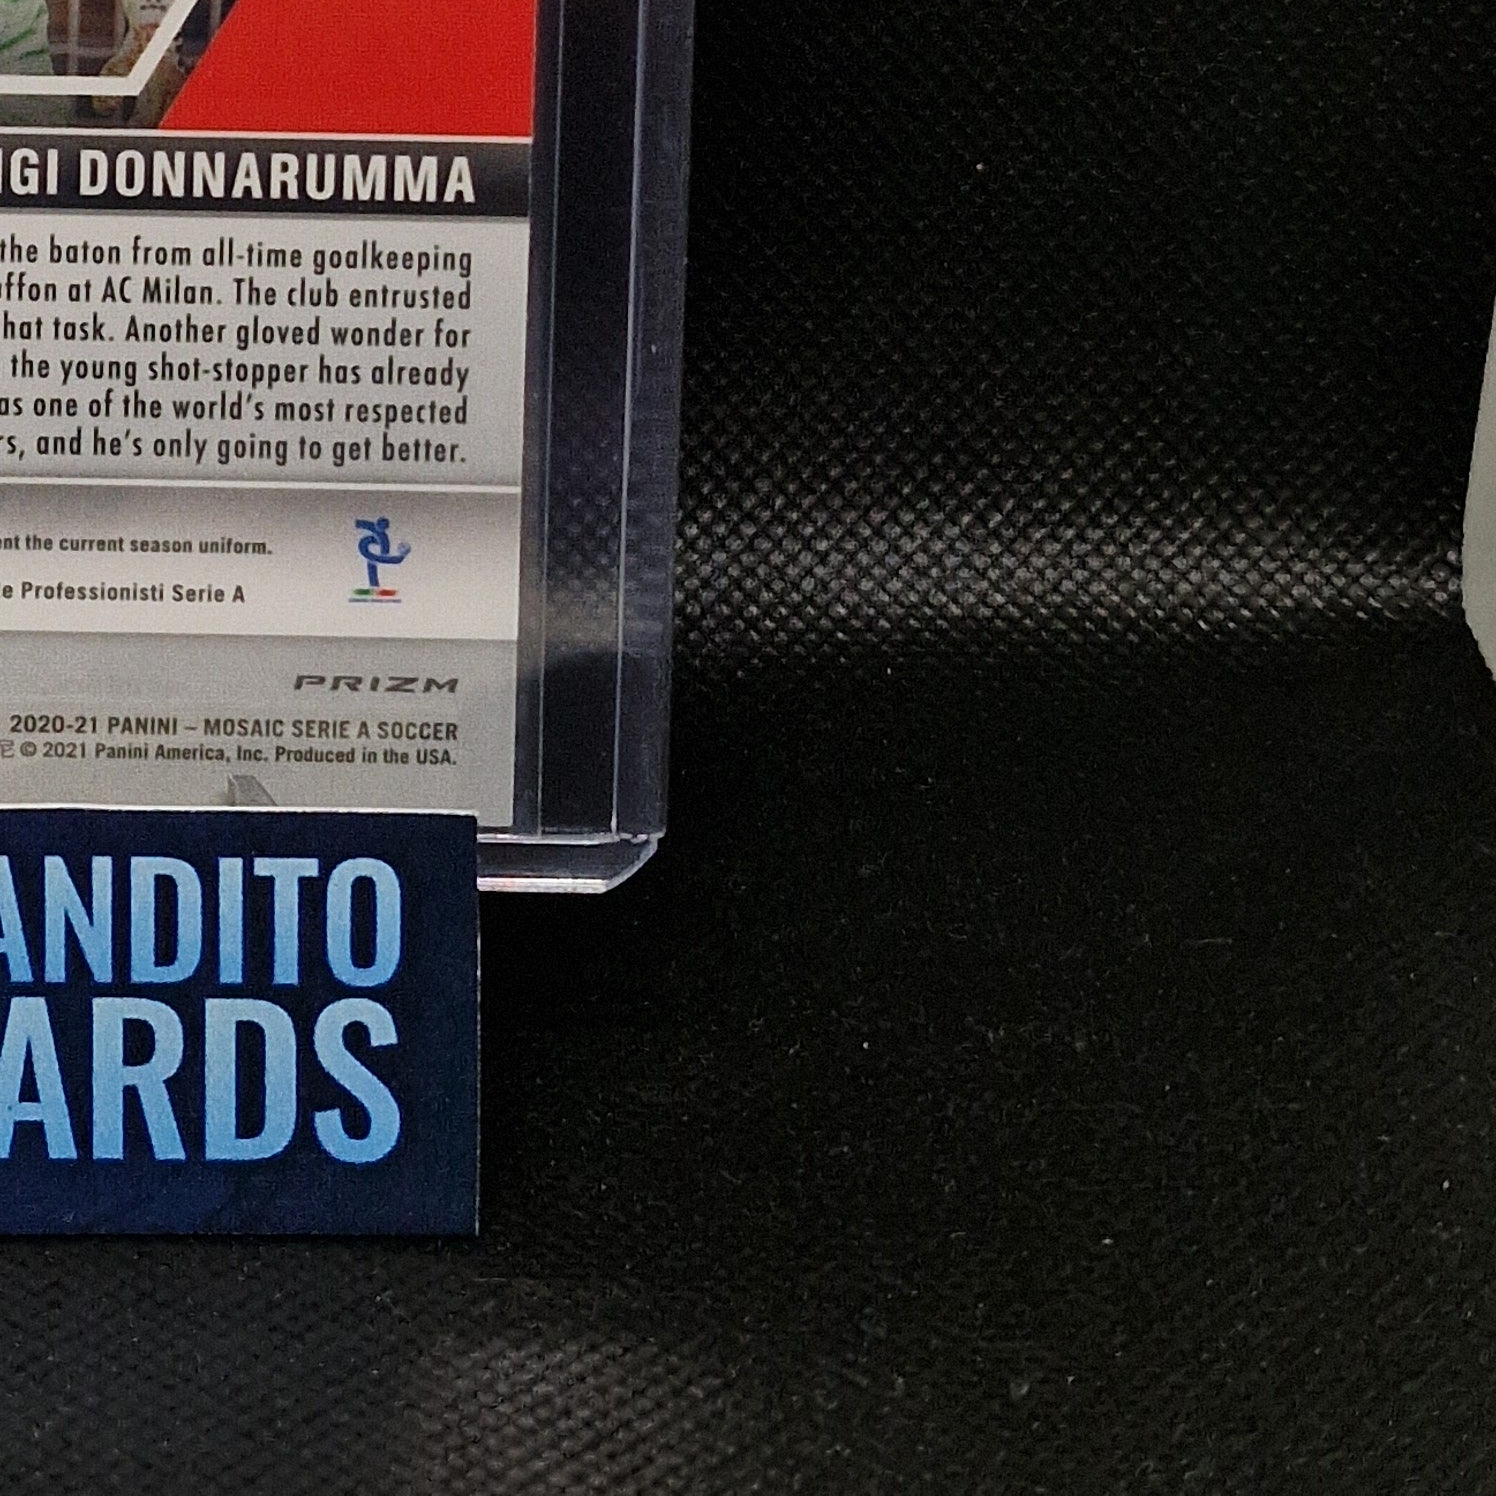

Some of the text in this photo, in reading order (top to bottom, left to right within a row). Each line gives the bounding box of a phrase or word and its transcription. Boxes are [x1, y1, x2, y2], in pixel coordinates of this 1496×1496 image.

[79, 148, 476, 203] DONNARUMMA
[0, 233, 38, 263] the
[49, 234, 121, 264] baton
[132, 236, 192, 265] from
[202, 237, 303, 267] all-time
[312, 240, 472, 278] goalkeeping
[68, 277, 92, 302] at
[101, 274, 132, 303] AC
[142, 274, 222, 304] Milan.
[233, 275, 277, 305] The
[287, 276, 339, 307] club
[349, 279, 471, 309] entrusted
[52, 311, 114, 341] task.
[125, 312, 227, 343] Another
[236, 314, 320, 348] gloved
[330, 315, 425, 347] wonder
[434, 316, 471, 348] for
[10, 349, 50, 378] the
[60, 357, 137, 386] young
[148, 351, 309, 389] shot-stopper
[318, 354, 362, 384] has
[371, 356, 469, 392] already
[33, 395, 78, 417] one
[88, 389, 113, 417] of
[122, 389, 162, 418] the
[274, 396, 335, 422] most
[345, 393, 468, 429] respected
[36, 427, 82, 455] and
[153, 428, 208, 463] only
[217, 430, 288, 464] going
[298, 433, 322, 459] to
[332, 435, 372, 465] get
[381, 430, 466, 462] better.
[25, 534, 54, 550] the
[59, 536, 125, 552] current
[129, 539, 193, 552] season
[198, 536, 273, 554] uniform.
[21, 580, 164, 601] Professionisti
[172, 583, 225, 602] Serie
[232, 584, 246, 603] A
[294, 674, 459, 693] PRIZM
[9, 713, 97, 733] 2020-21
[107, 715, 178, 735] PANINI
[203, 716, 285, 737] MOSAIC
[291, 718, 351, 739] SERIE
[356, 719, 371, 739] A
[377, 720, 459, 741] SOCCER
[42, 739, 86, 758] 2021
[94, 741, 149, 760] Panini
[154, 742, 231, 763] America,
[236, 743, 269, 762] Inc.
[274, 744, 356, 763] Produced
[361, 745, 378, 764] in
[382, 746, 410, 764] the
[415, 747, 457, 765] USA.
